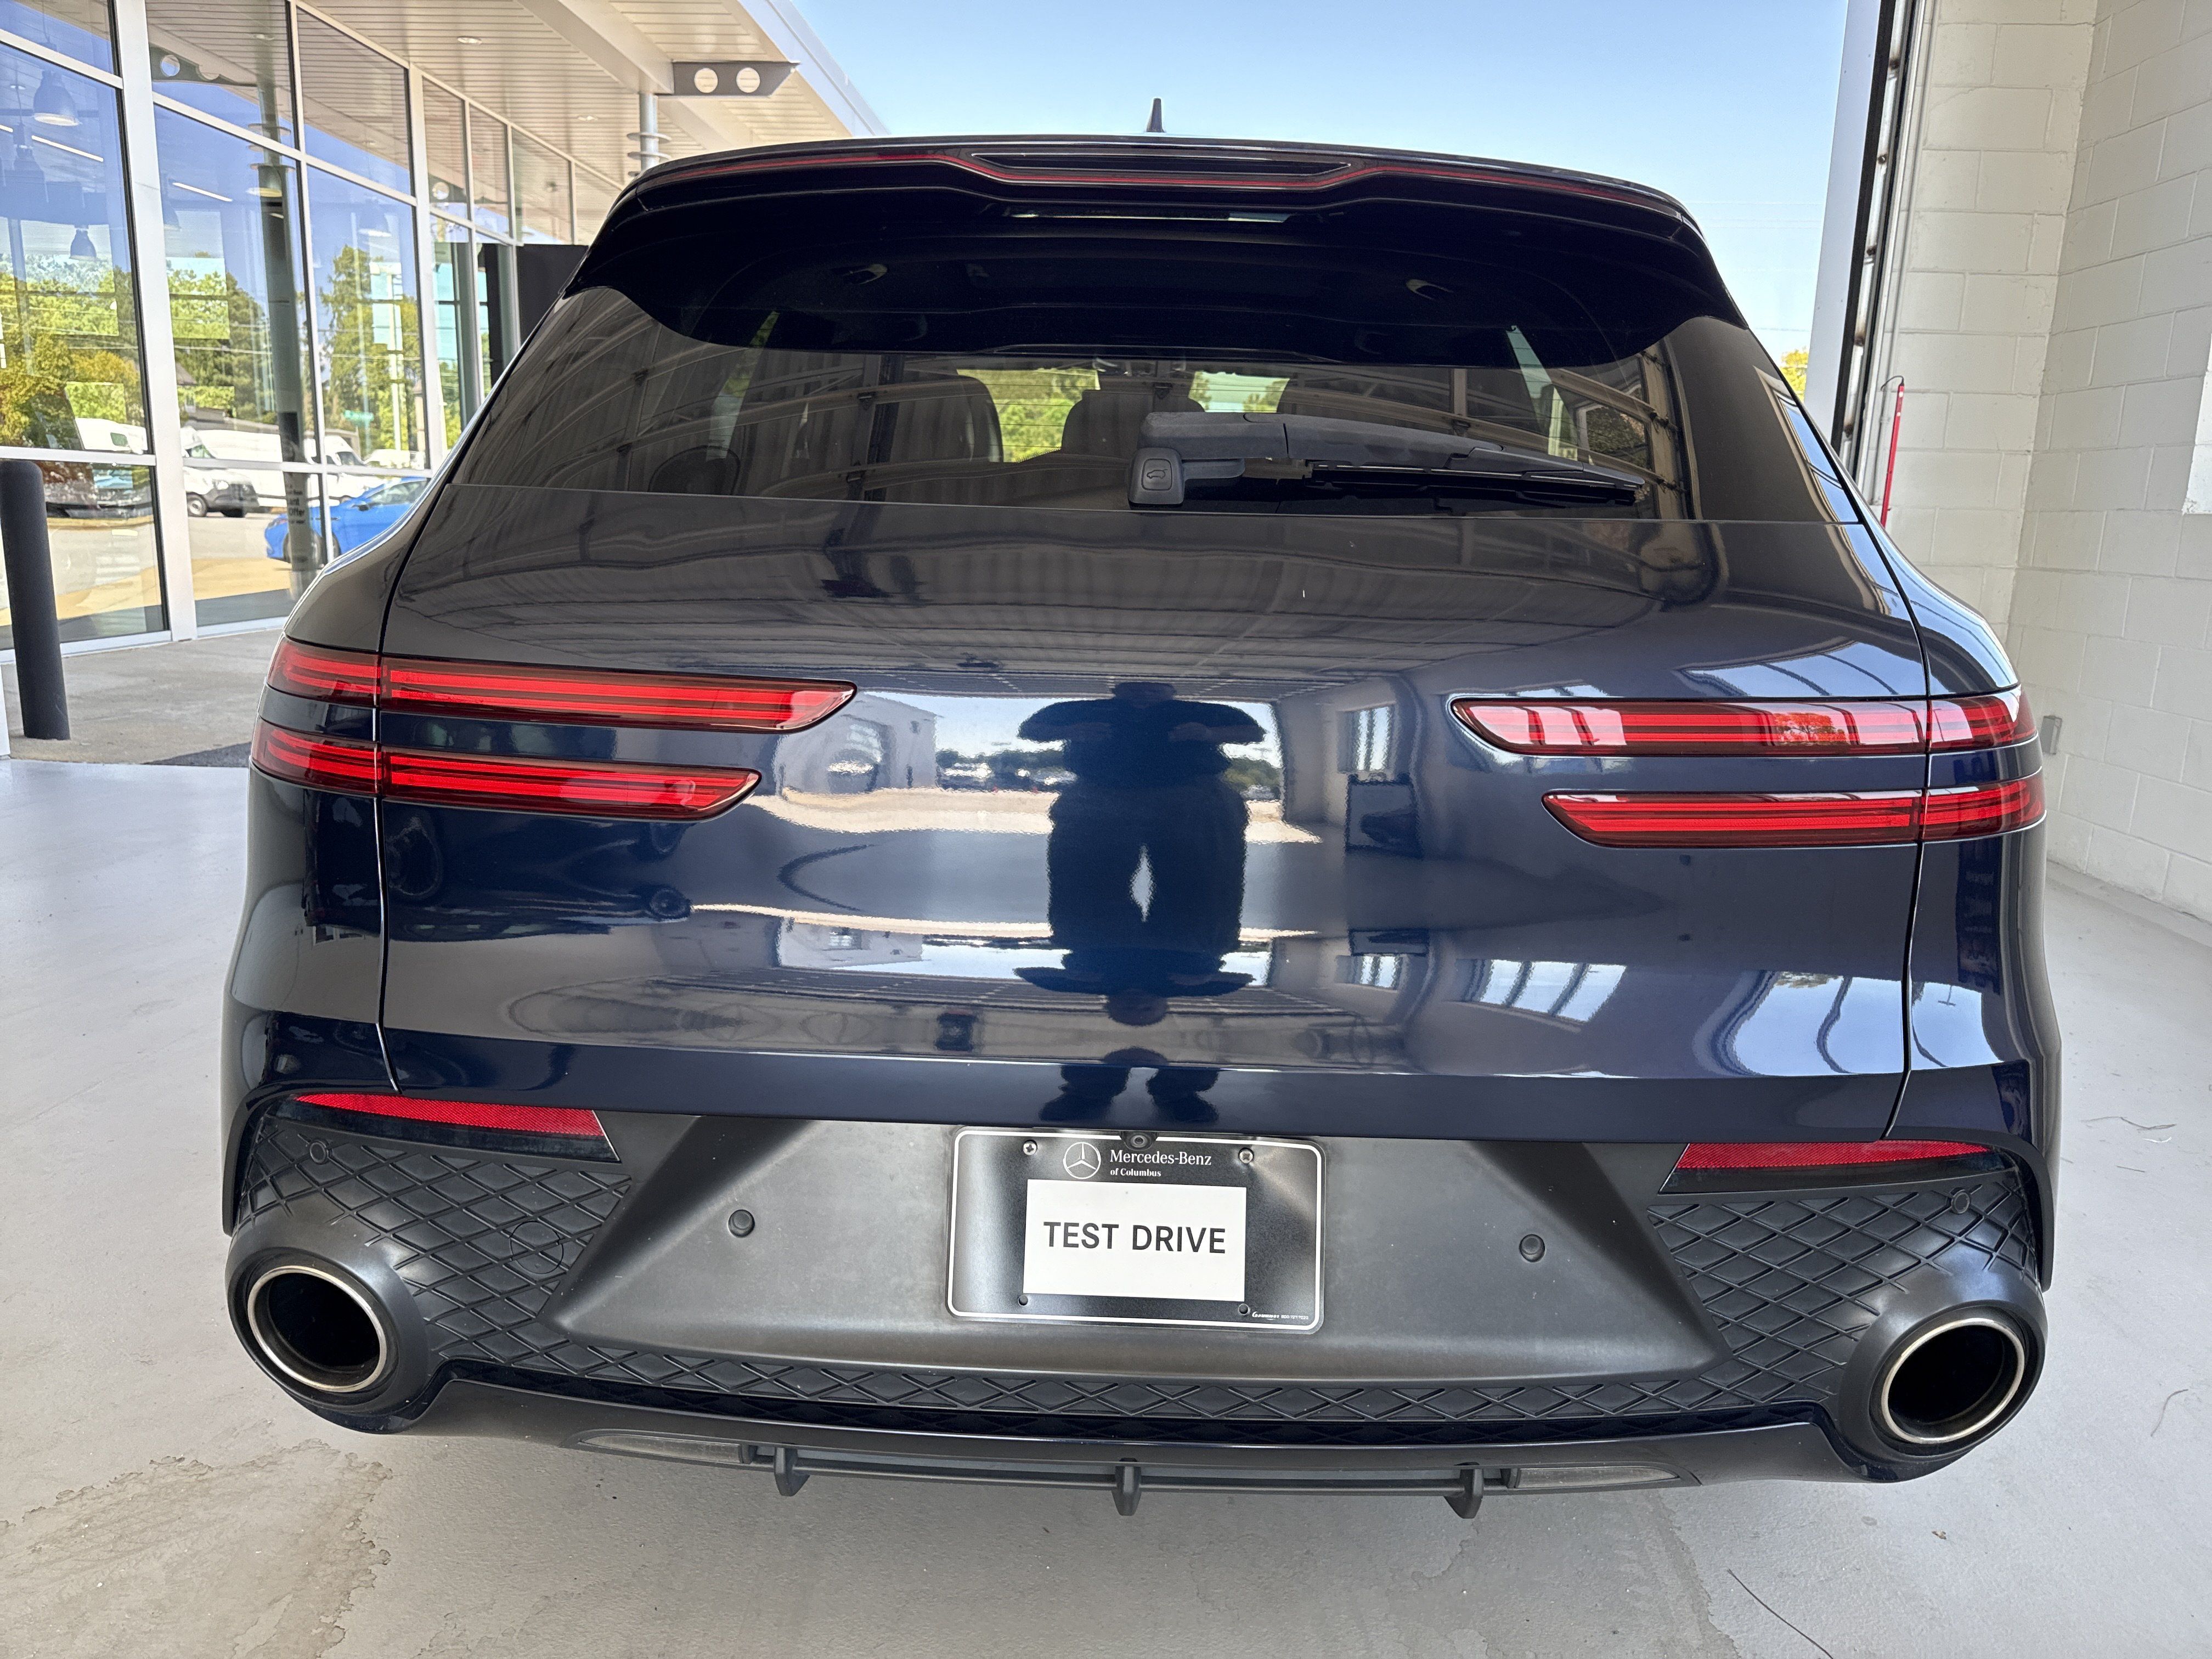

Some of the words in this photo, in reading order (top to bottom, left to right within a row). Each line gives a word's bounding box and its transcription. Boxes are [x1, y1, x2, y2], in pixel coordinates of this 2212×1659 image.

[1110, 1149, 1212, 1166] Mercedes-Benz
[1120, 1168, 1161, 1177] Columbus
[1043, 1221, 1119, 1249] TEST
[1132, 1224, 1226, 1254] DRIVE
